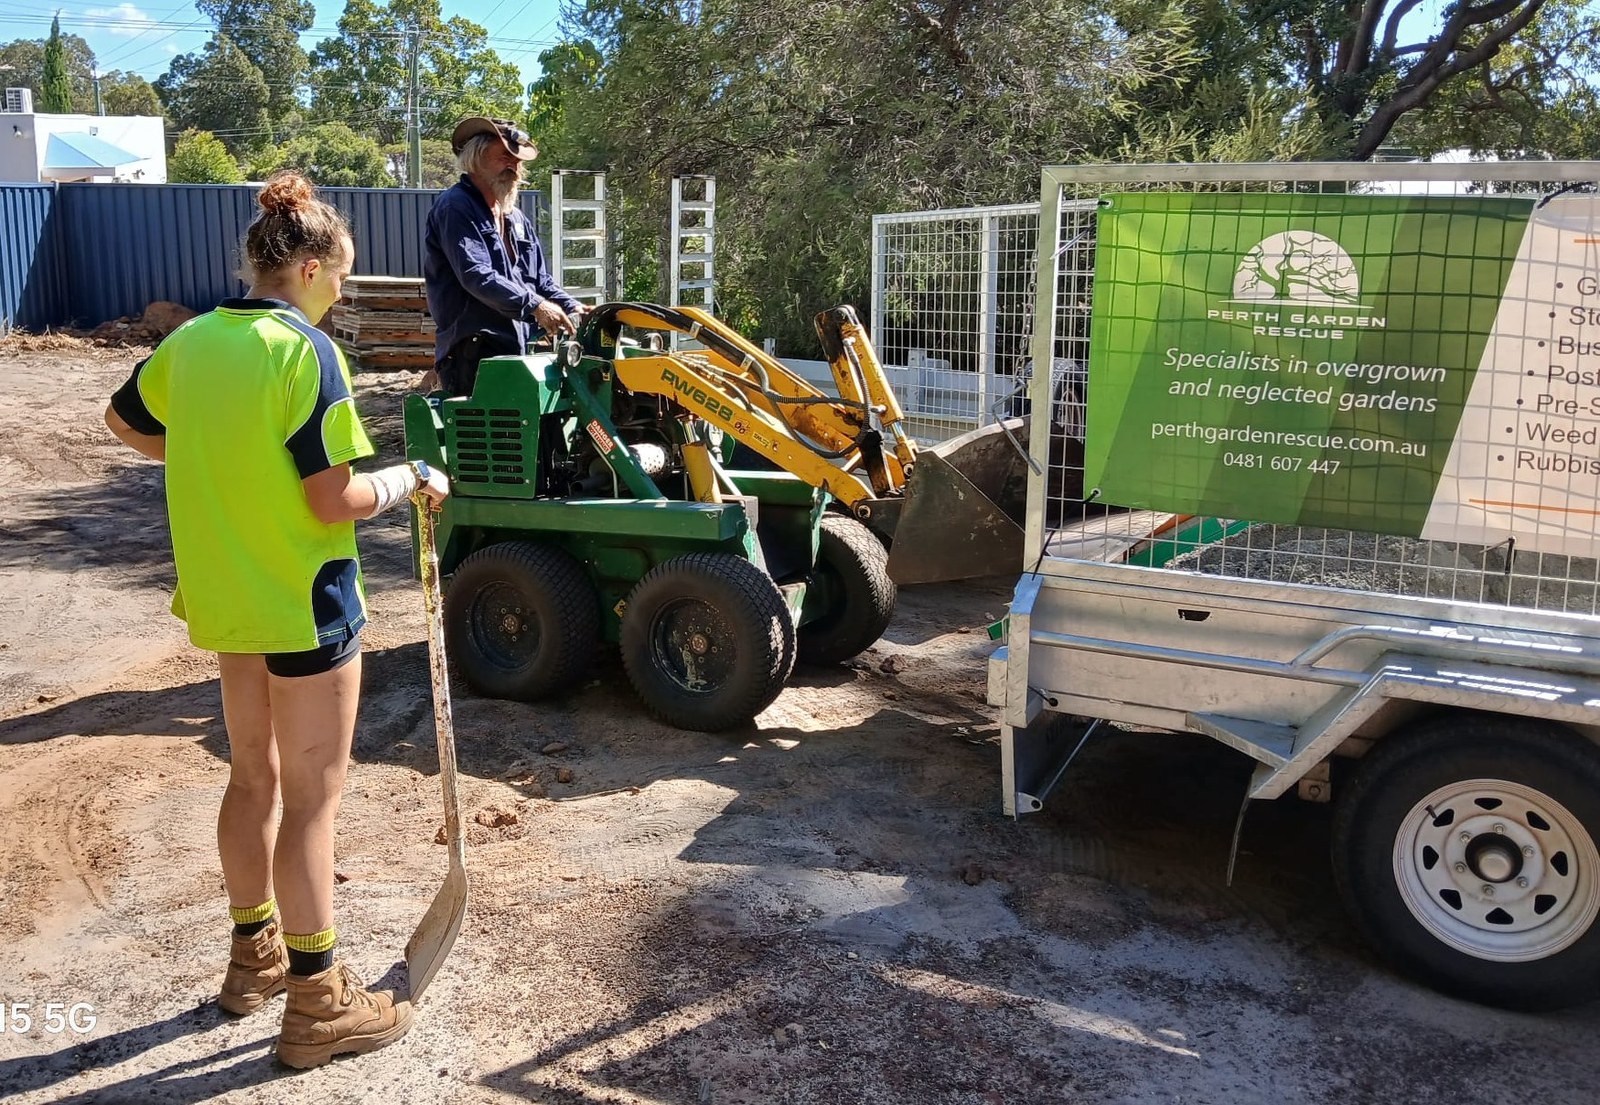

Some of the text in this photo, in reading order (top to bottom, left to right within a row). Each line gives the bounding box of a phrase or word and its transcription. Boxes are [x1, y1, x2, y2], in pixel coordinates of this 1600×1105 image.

[1577, 277, 1600, 297] G
[1207, 309, 1387, 328] PERTH GARDEN
[1253, 326, 1344, 340] RESCUE
[1163, 347, 1447, 385] Specialists in overgrown
[1168, 377, 1438, 413] and neglected gardens
[591, 420, 614, 449] DANGER
[1151, 421, 1427, 457] perthgardenrescue.com.au
[1525, 421, 1597, 446] Weed
[1223, 452, 1341, 475] 0481 607 447
[1516, 450, 1600, 476] Rubbis
